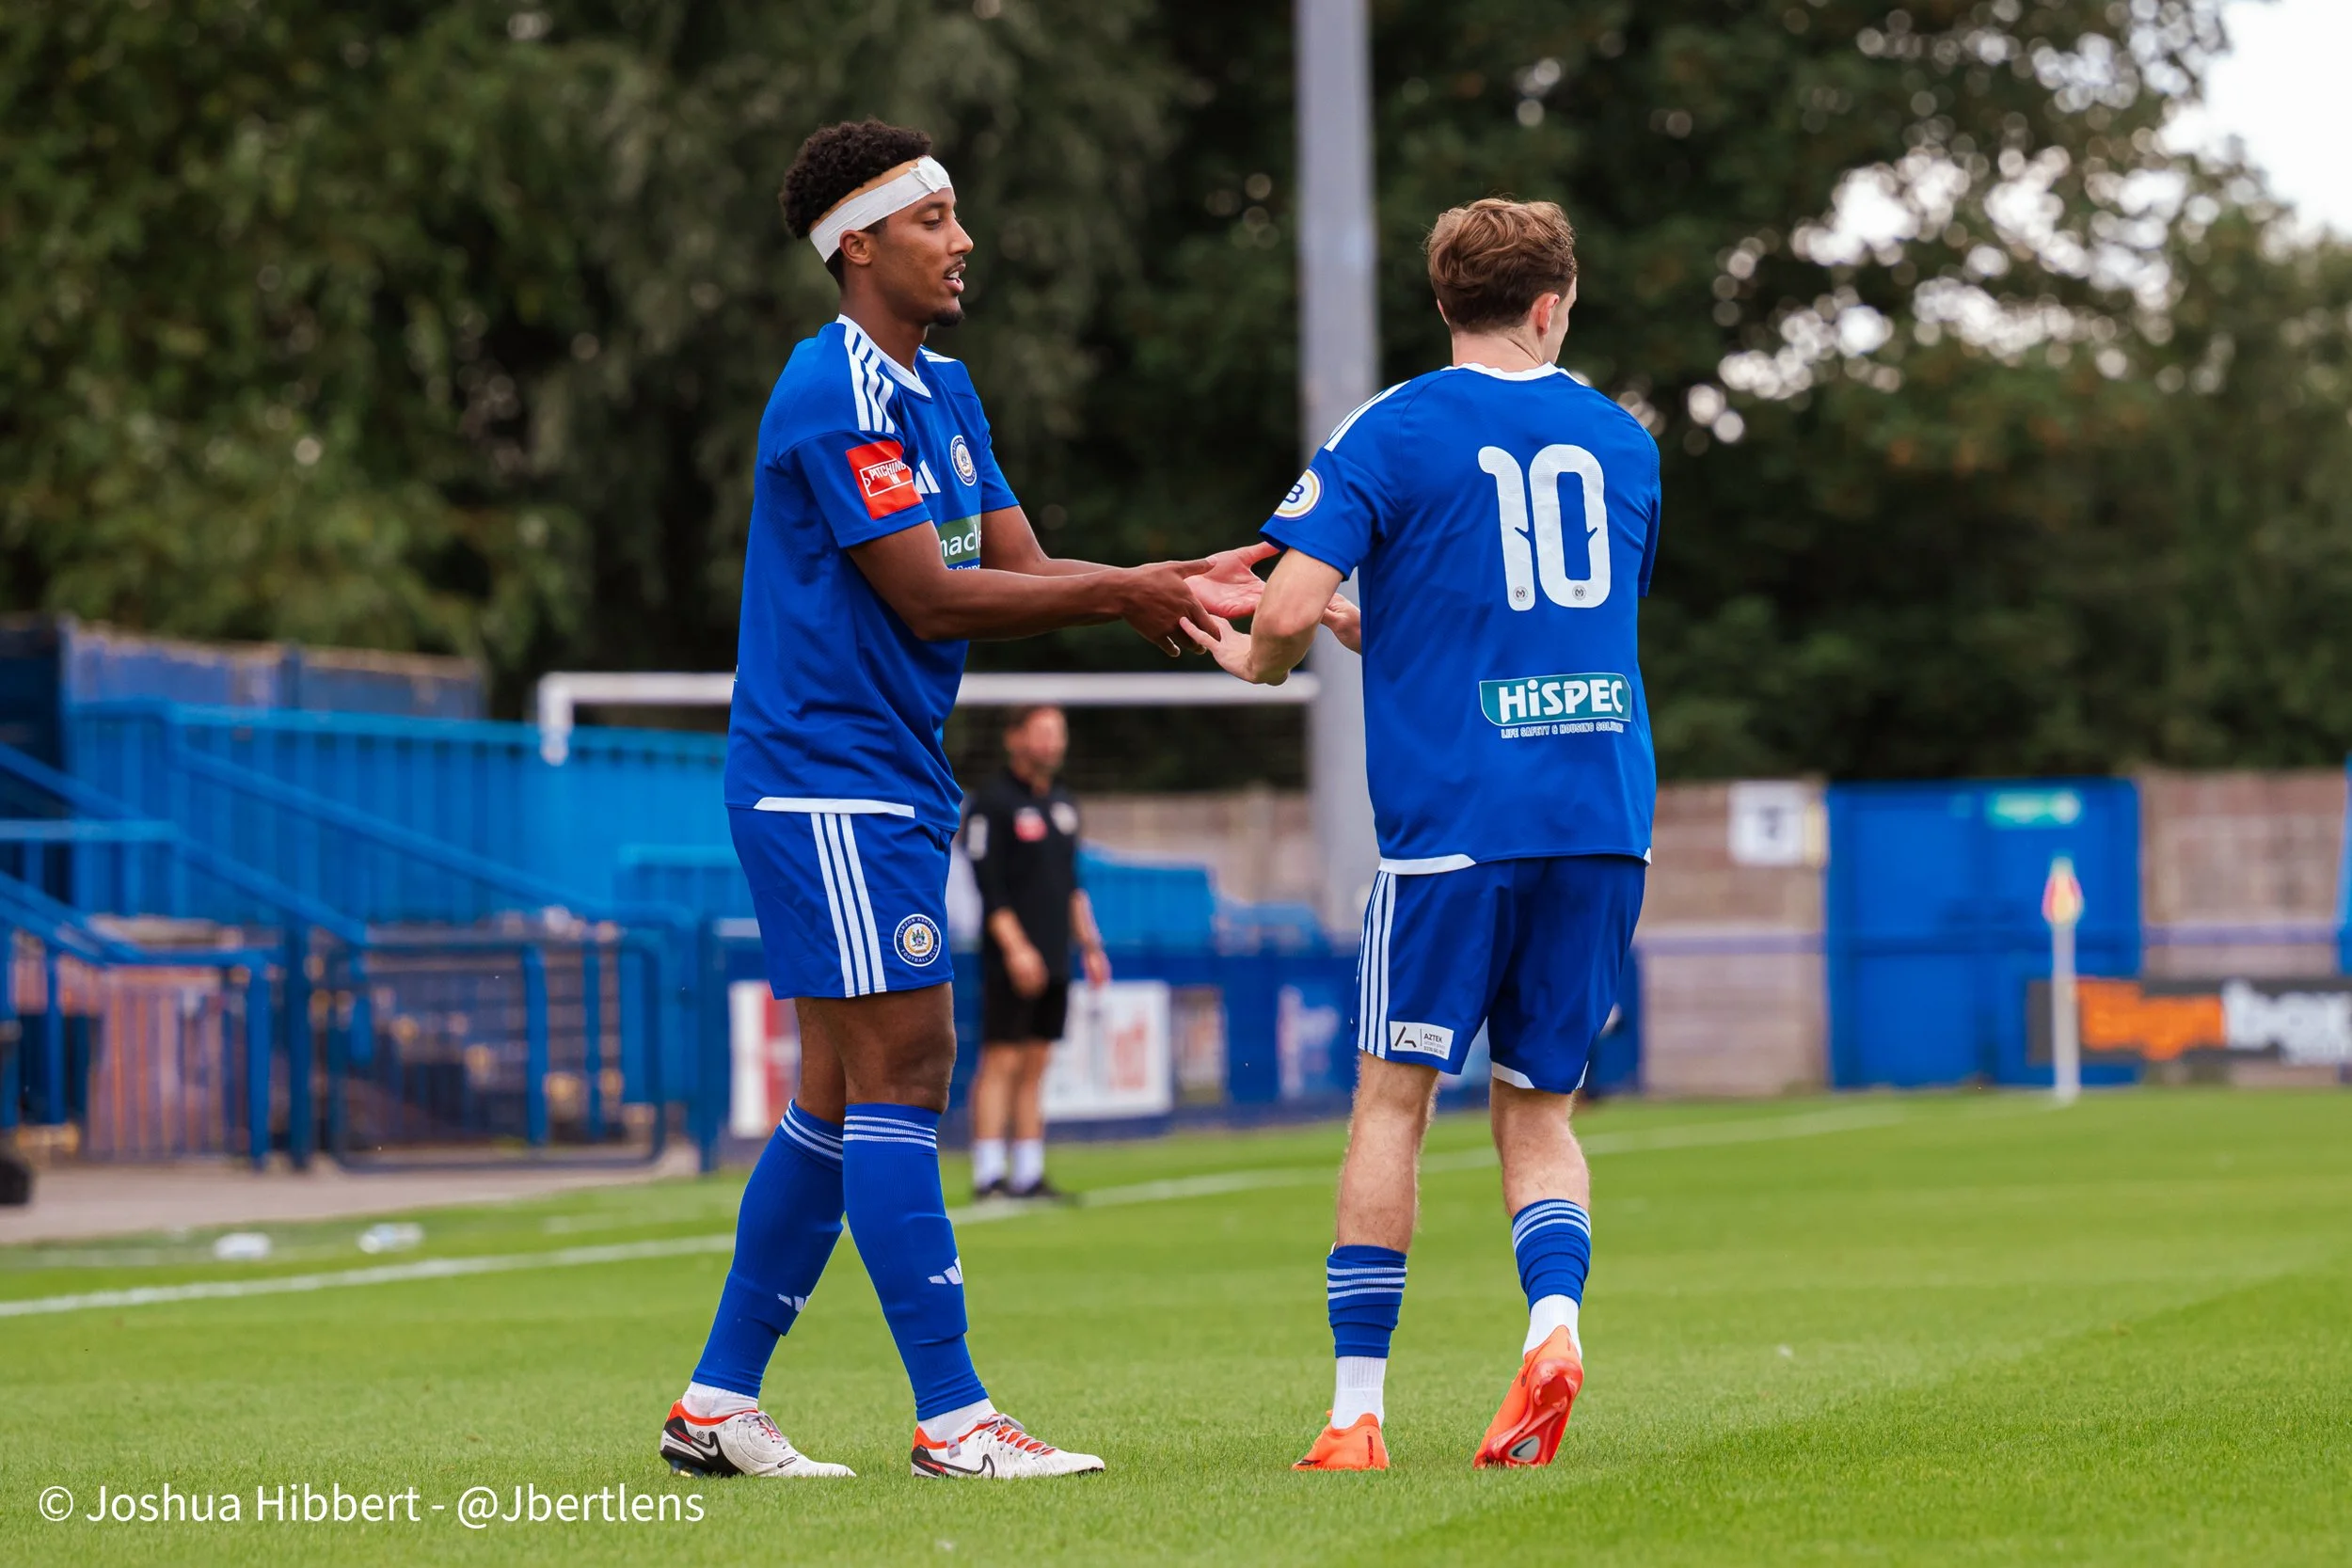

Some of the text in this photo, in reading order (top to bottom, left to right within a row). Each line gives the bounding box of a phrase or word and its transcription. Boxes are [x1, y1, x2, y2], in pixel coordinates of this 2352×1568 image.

[1477, 444, 1611, 611] 10
[1520, 725, 1550, 737] SAFETY
[1560, 722, 1594, 734] HOUSING
